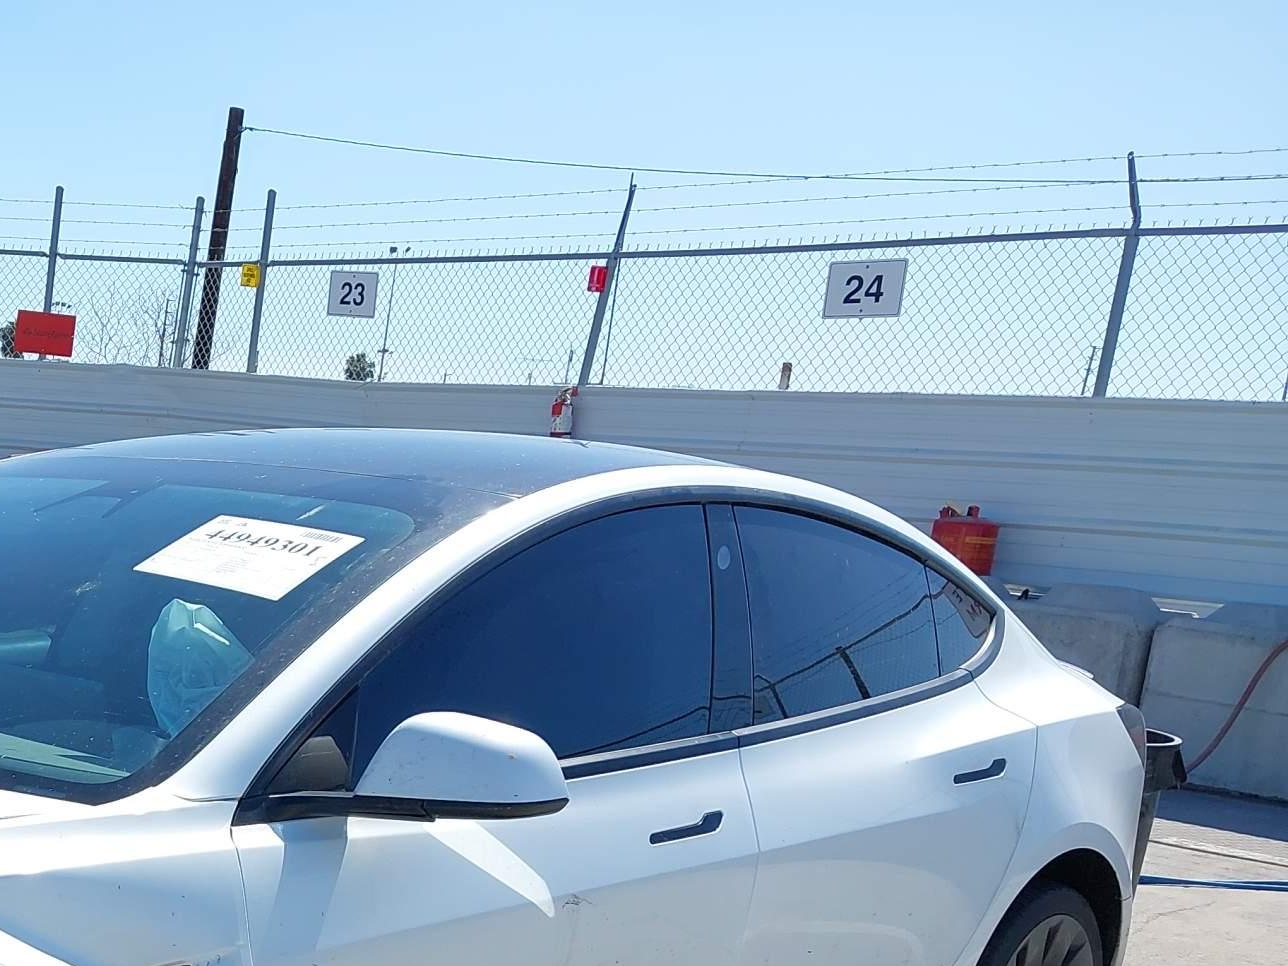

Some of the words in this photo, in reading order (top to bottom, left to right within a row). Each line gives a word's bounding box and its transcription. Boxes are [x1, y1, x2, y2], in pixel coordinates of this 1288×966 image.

[339, 281, 366, 307] 23
[842, 274, 884, 305] 24
[205, 529, 323, 557] 44949301
